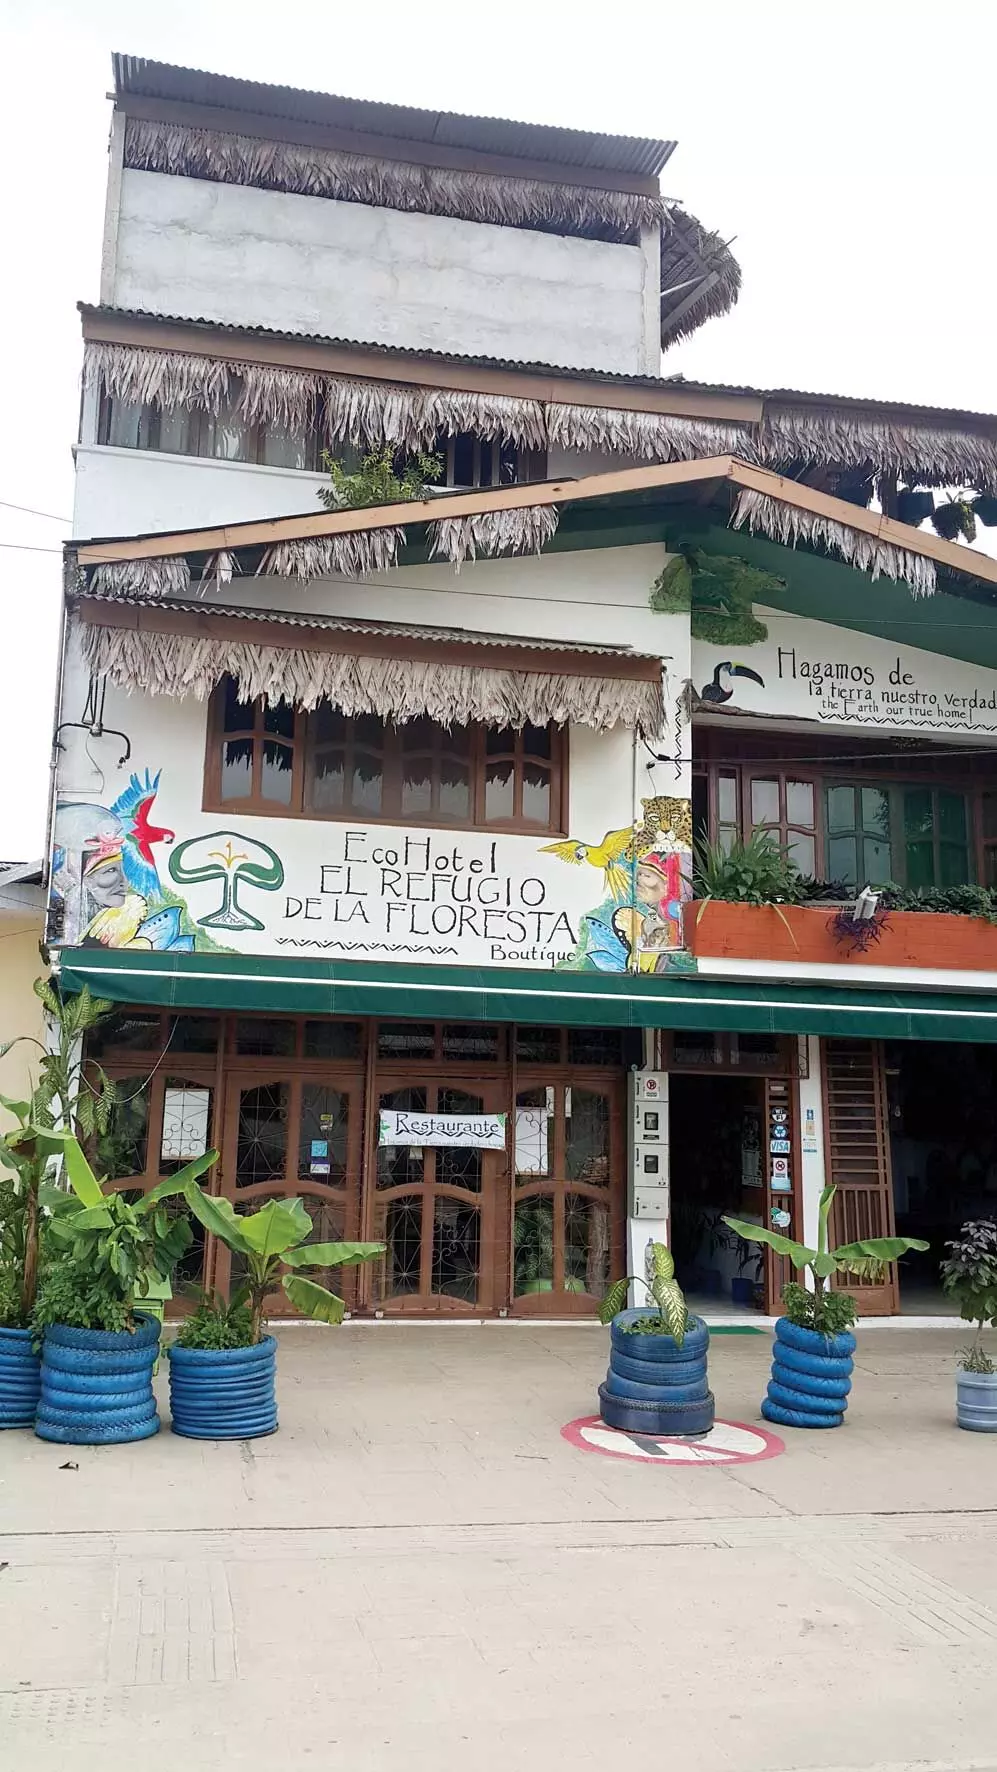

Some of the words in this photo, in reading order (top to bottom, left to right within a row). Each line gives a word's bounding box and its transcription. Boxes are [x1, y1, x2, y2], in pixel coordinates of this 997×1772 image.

[777, 646, 875, 685] Hagamos
[888, 657, 915, 686] de
[808, 680, 822, 696] la
[830, 681, 872, 700] tierra
[881, 689, 937, 705] nuestro
[822, 695, 839, 710] the
[843, 698, 879, 716] Earth
[885, 707, 904, 716] our
[908, 706, 933, 717] true
[320, 865, 368, 897] EL
[380, 867, 546, 906] REFUGIO
[282, 896, 322, 920] DE
[333, 898, 370, 924] LA
[386, 902, 578, 945] FLORESTA
[395, 1113, 500, 1133] Restaurante
[772, 1141, 789, 1151] VISA
